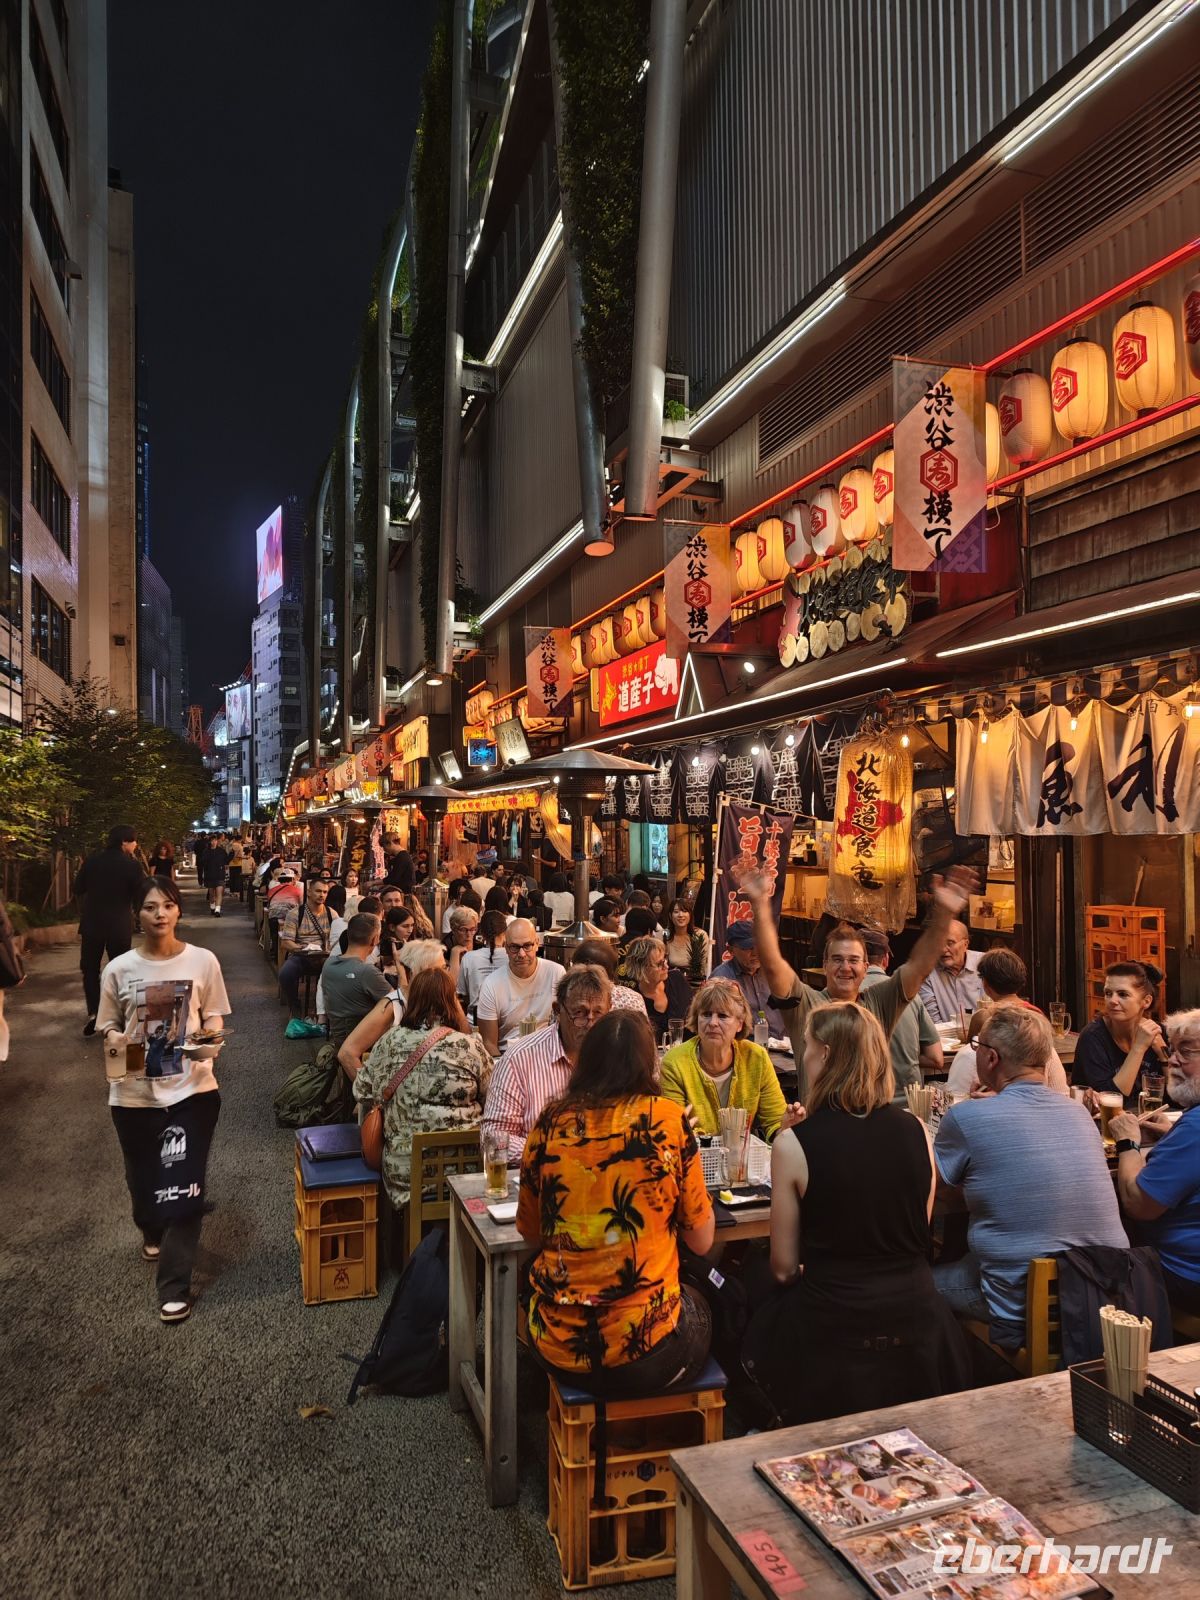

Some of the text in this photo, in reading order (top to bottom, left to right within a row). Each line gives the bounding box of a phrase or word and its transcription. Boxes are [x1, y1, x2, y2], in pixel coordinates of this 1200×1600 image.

[618, 671, 654, 712] 道産子
[851, 751, 883, 890] 北海道食市
[753, 1542, 788, 1576] 405
